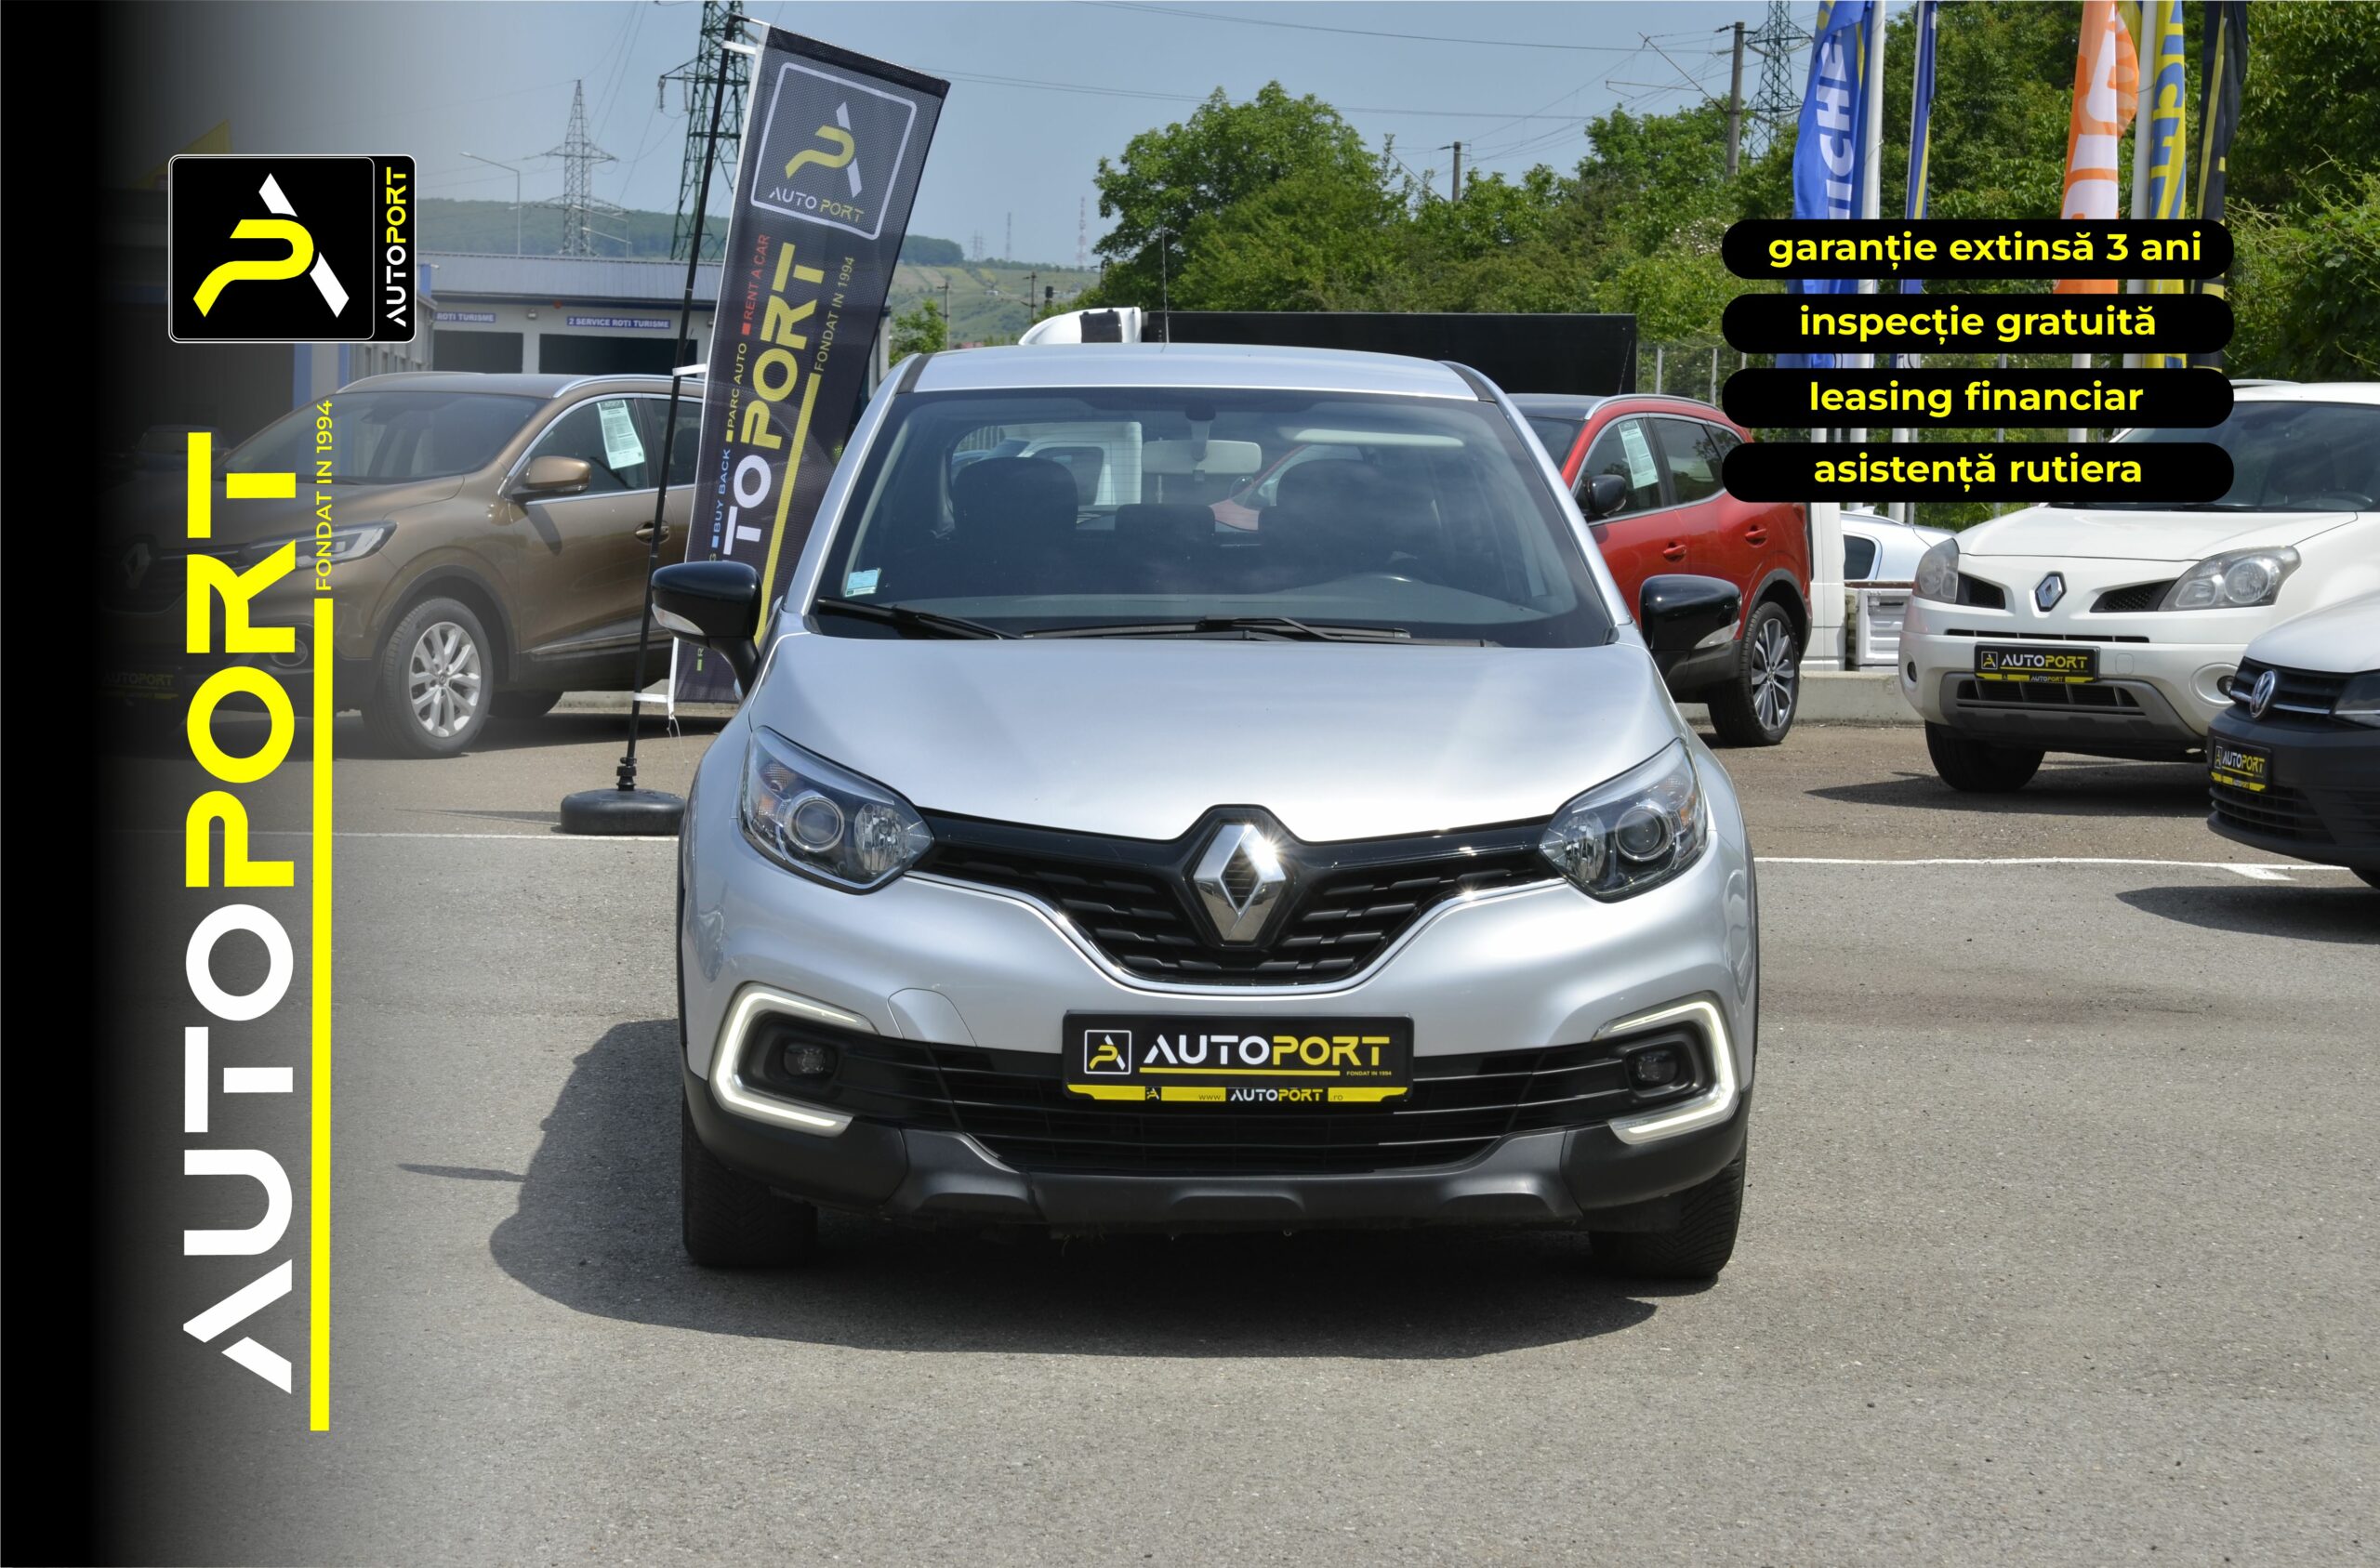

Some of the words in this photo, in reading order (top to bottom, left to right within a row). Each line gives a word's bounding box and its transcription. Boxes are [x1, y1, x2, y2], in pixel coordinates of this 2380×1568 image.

[769, 187, 817, 210] AUTO
[820, 199, 865, 223] PORT
[754, 234, 771, 267] CAR
[751, 270, 762, 279] A
[745, 282, 760, 320] RENT
[814, 310, 839, 372] FONDAT
[832, 293, 844, 308] IN
[838, 257, 855, 287] 1994
[575, 317, 611, 326] SERVICE
[612, 319, 631, 327] ROTI
[633, 320, 669, 328] TURISME
[723, 243, 826, 556] TOPORT
[727, 388, 741, 428] PARC
[734, 343, 747, 385] AUTO
[719, 449, 732, 494] BACK
[714, 500, 725, 533] BUY
[2001, 653, 2088, 668] AUTOPORT
[2222, 751, 2266, 773] AUTOPORT
[1144, 1034, 1390, 1066] AUTOPORT
[1230, 1087, 1324, 1102] AUTOPORT
